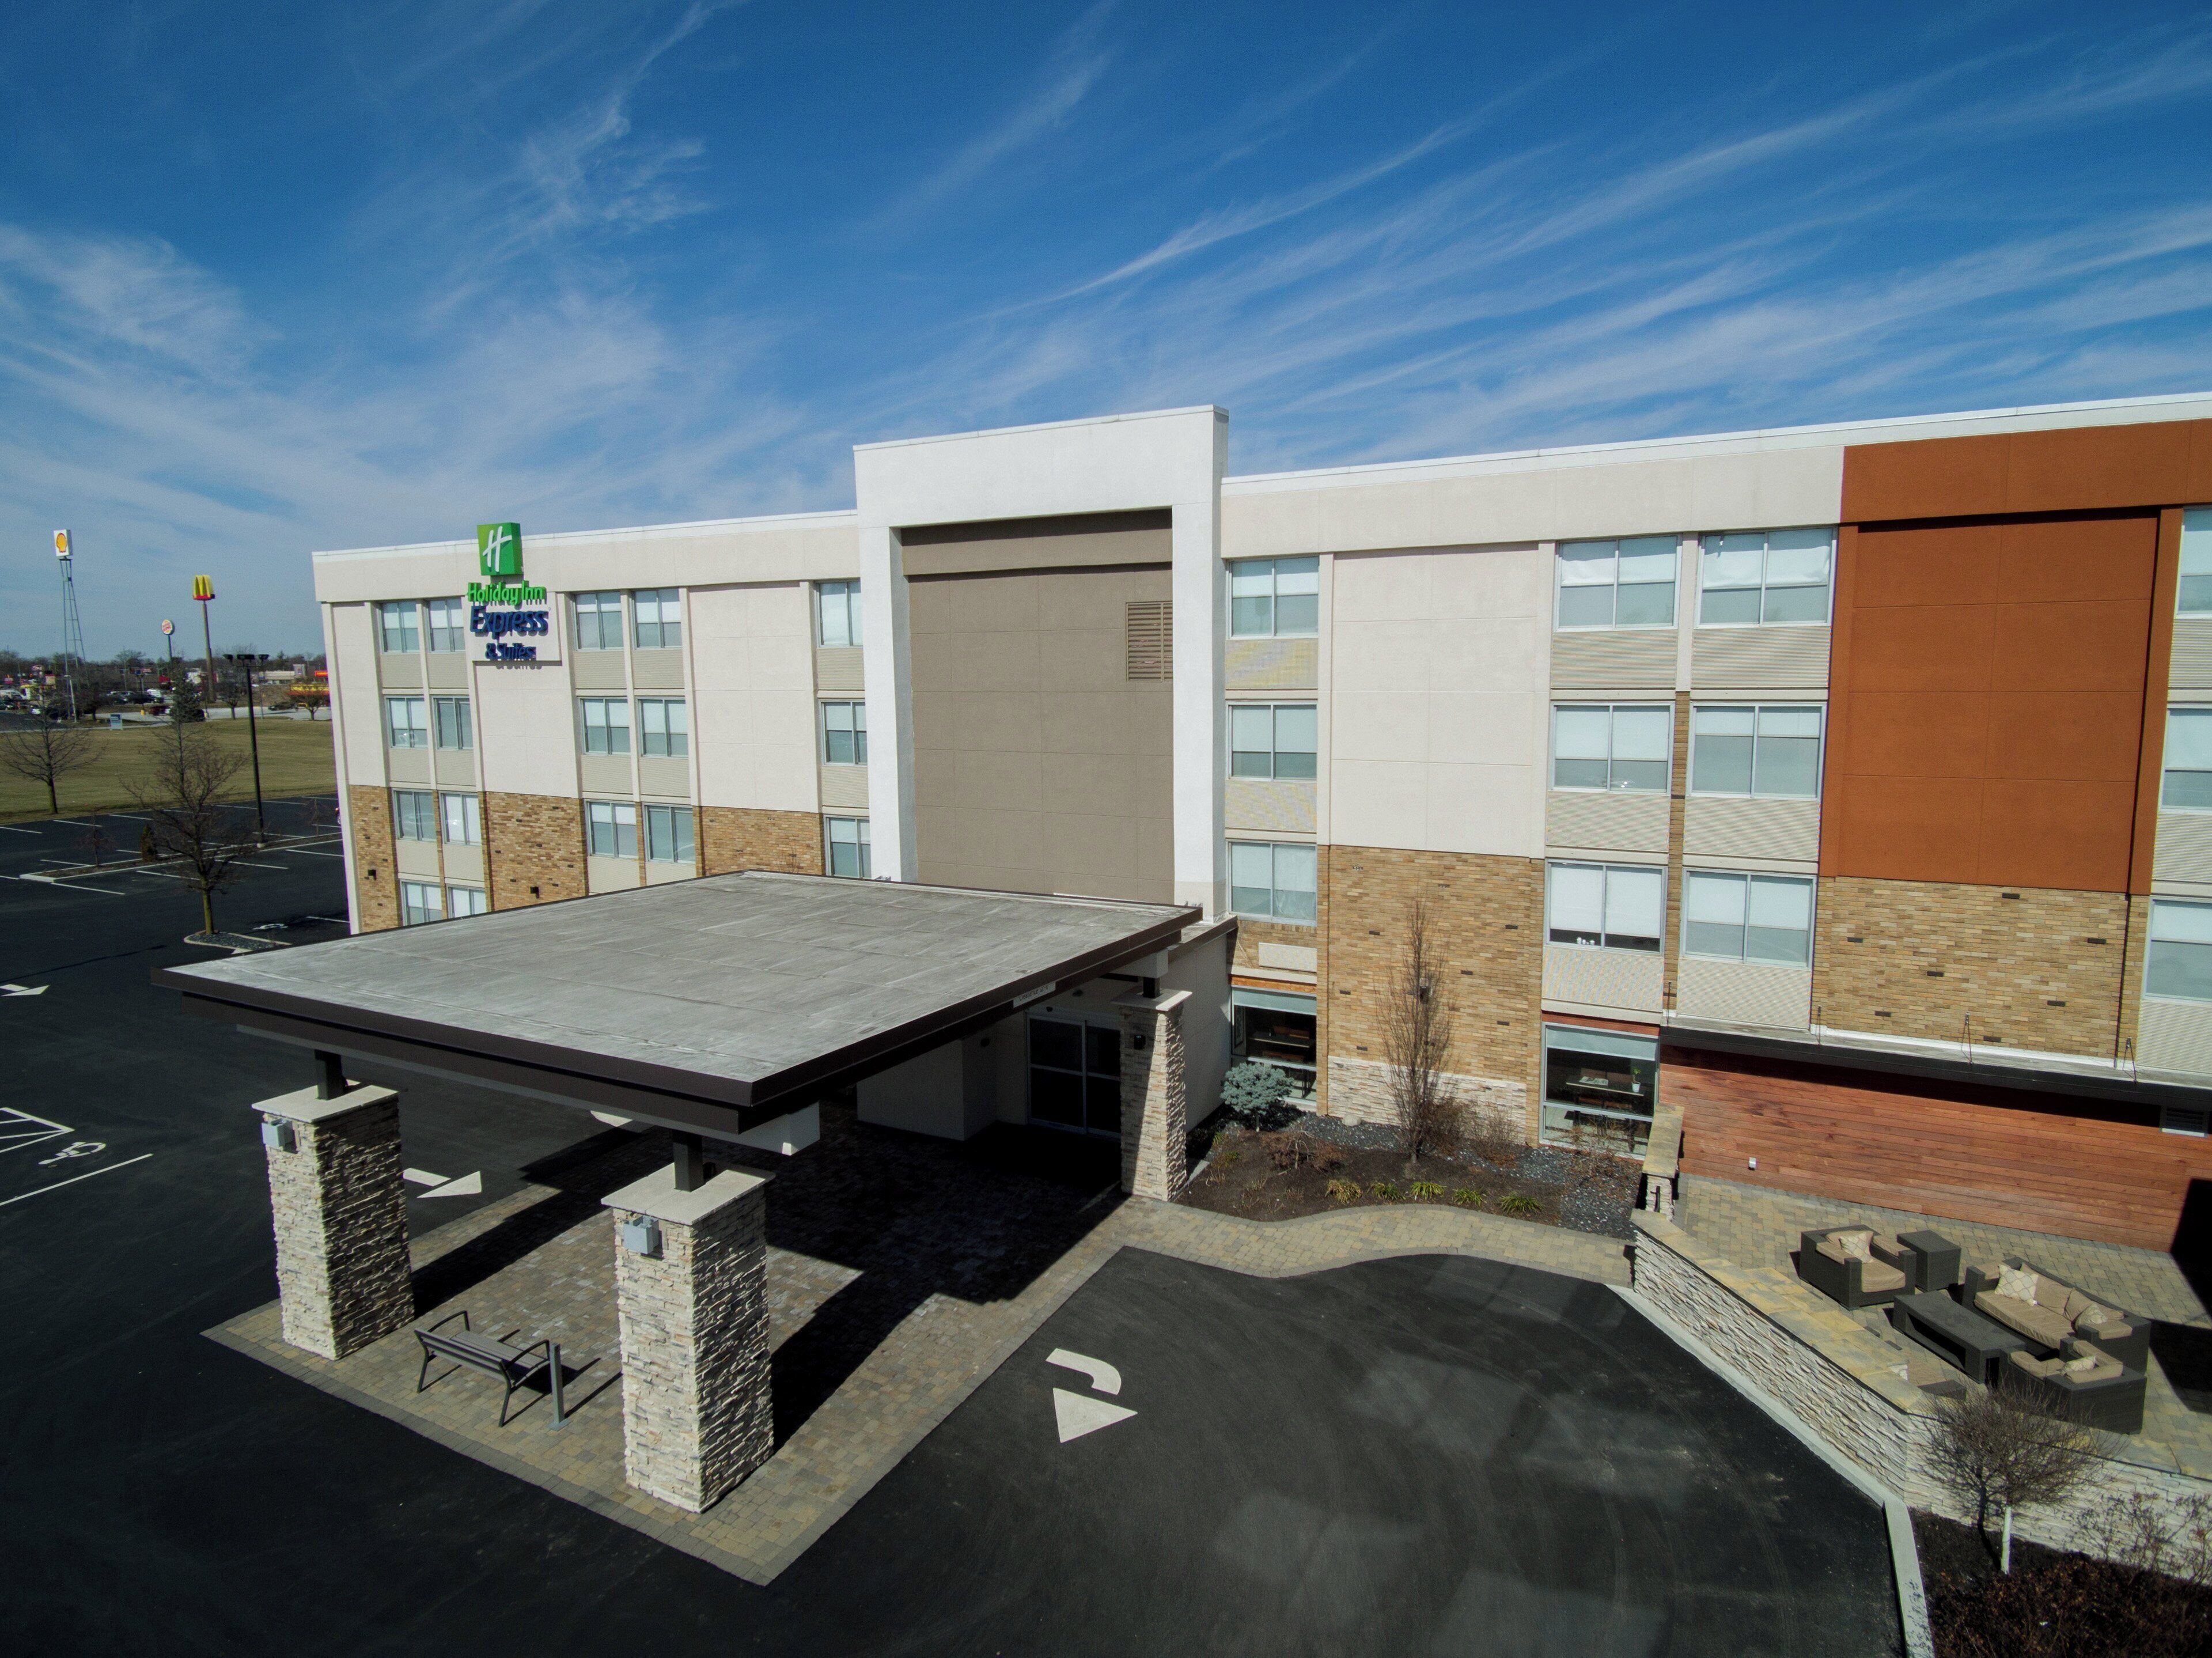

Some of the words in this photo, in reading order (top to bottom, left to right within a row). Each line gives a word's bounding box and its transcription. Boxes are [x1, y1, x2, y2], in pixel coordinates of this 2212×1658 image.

[468, 581, 520, 606] Holiday
[522, 580, 546, 600] Inn
[470, 605, 548, 640] Express
[485, 643, 497, 659] &
[497, 643, 536, 660] Suites
